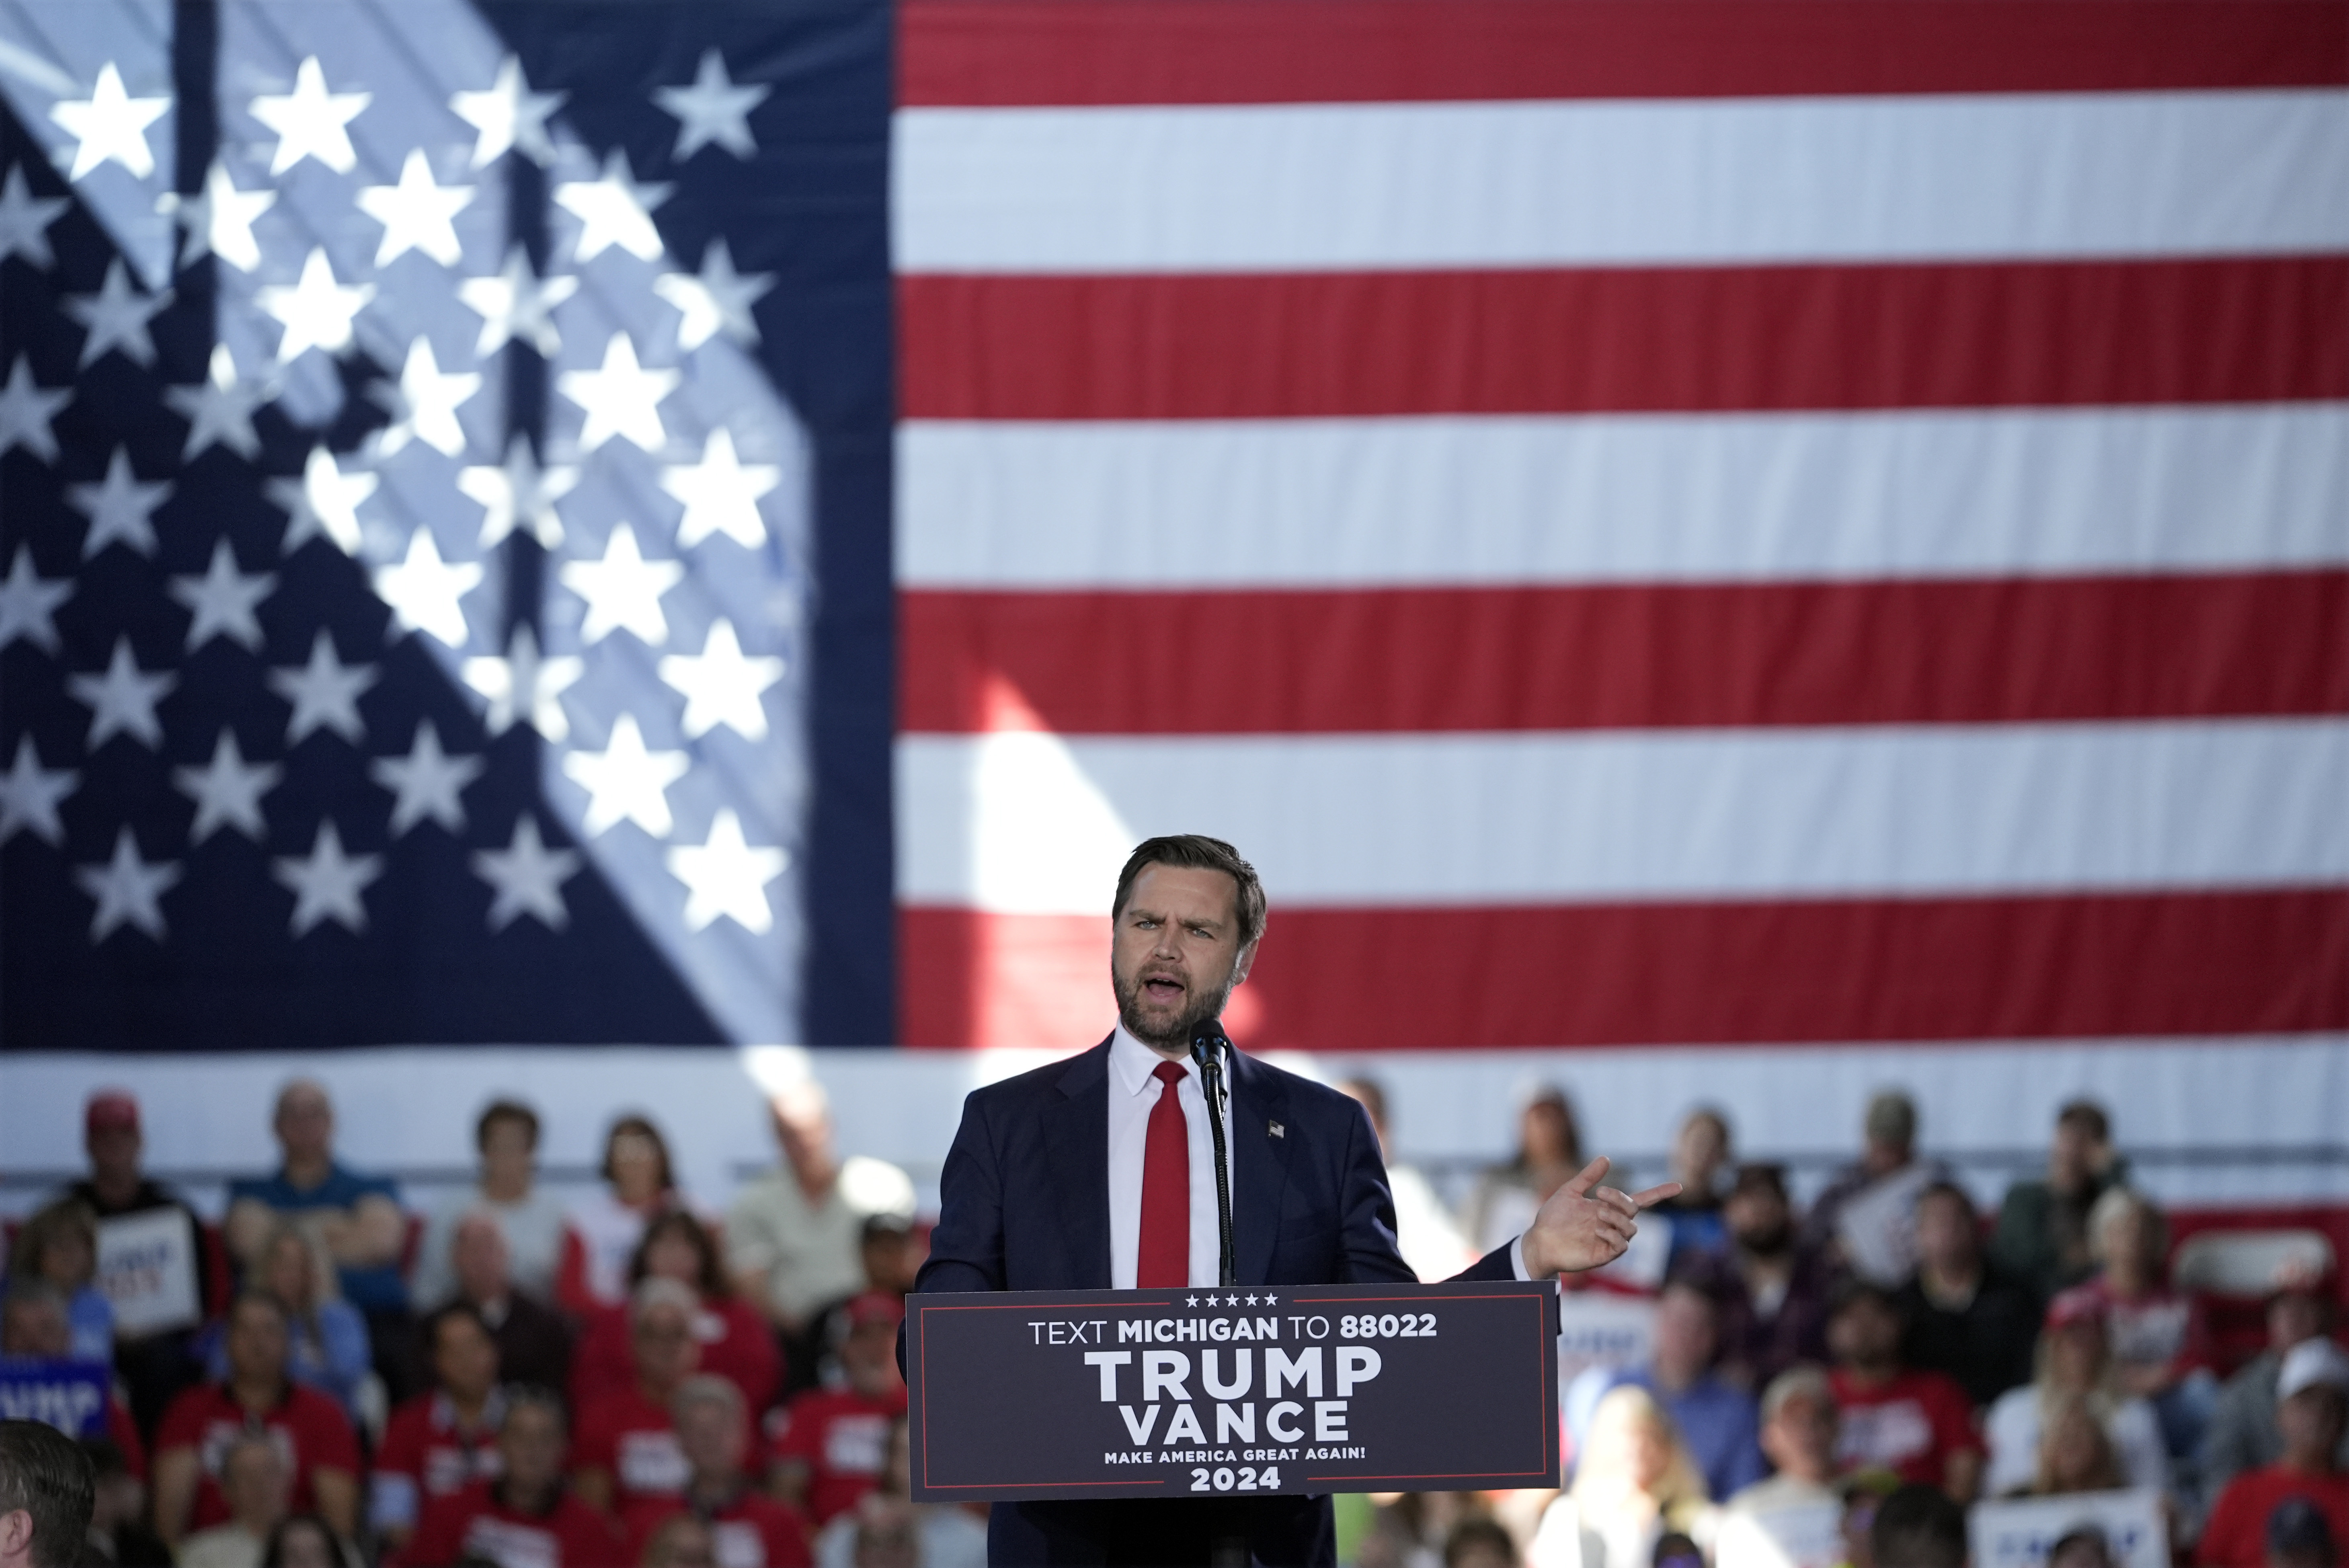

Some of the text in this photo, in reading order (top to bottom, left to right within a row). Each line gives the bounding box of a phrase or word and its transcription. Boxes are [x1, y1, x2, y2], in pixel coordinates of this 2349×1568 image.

[1028, 1313, 1437, 1345] TEXT MICHIGAN TO 88022
[1084, 1346, 1382, 1402] TRUMP
[1118, 1400, 1349, 1446] VANCE
[1105, 1447, 1365, 1464] MAKE AMERICA GREAT AGAIN!
[1191, 1466, 1281, 1491] 2024
